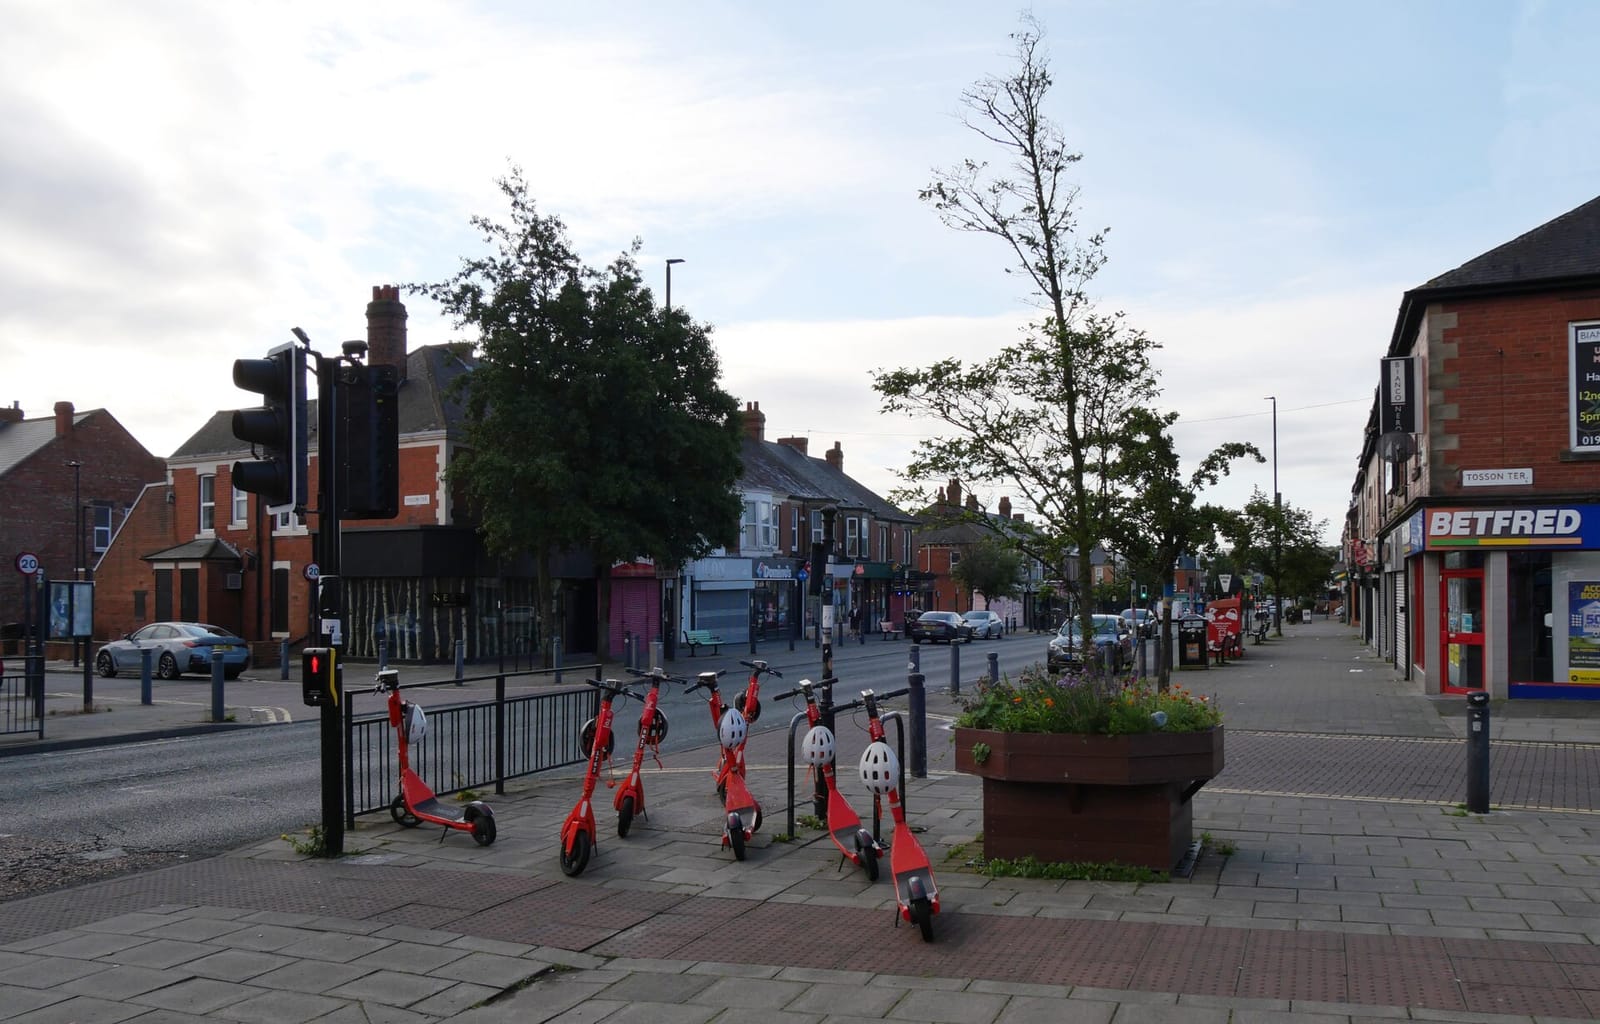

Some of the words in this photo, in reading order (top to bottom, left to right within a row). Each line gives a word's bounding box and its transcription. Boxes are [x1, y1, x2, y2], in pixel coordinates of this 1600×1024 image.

[1465, 473, 1504, 481] TOSSON
[1429, 509, 1582, 536] BETFRED
[21, 559, 37, 569] 20
[308, 566, 319, 576] 20
